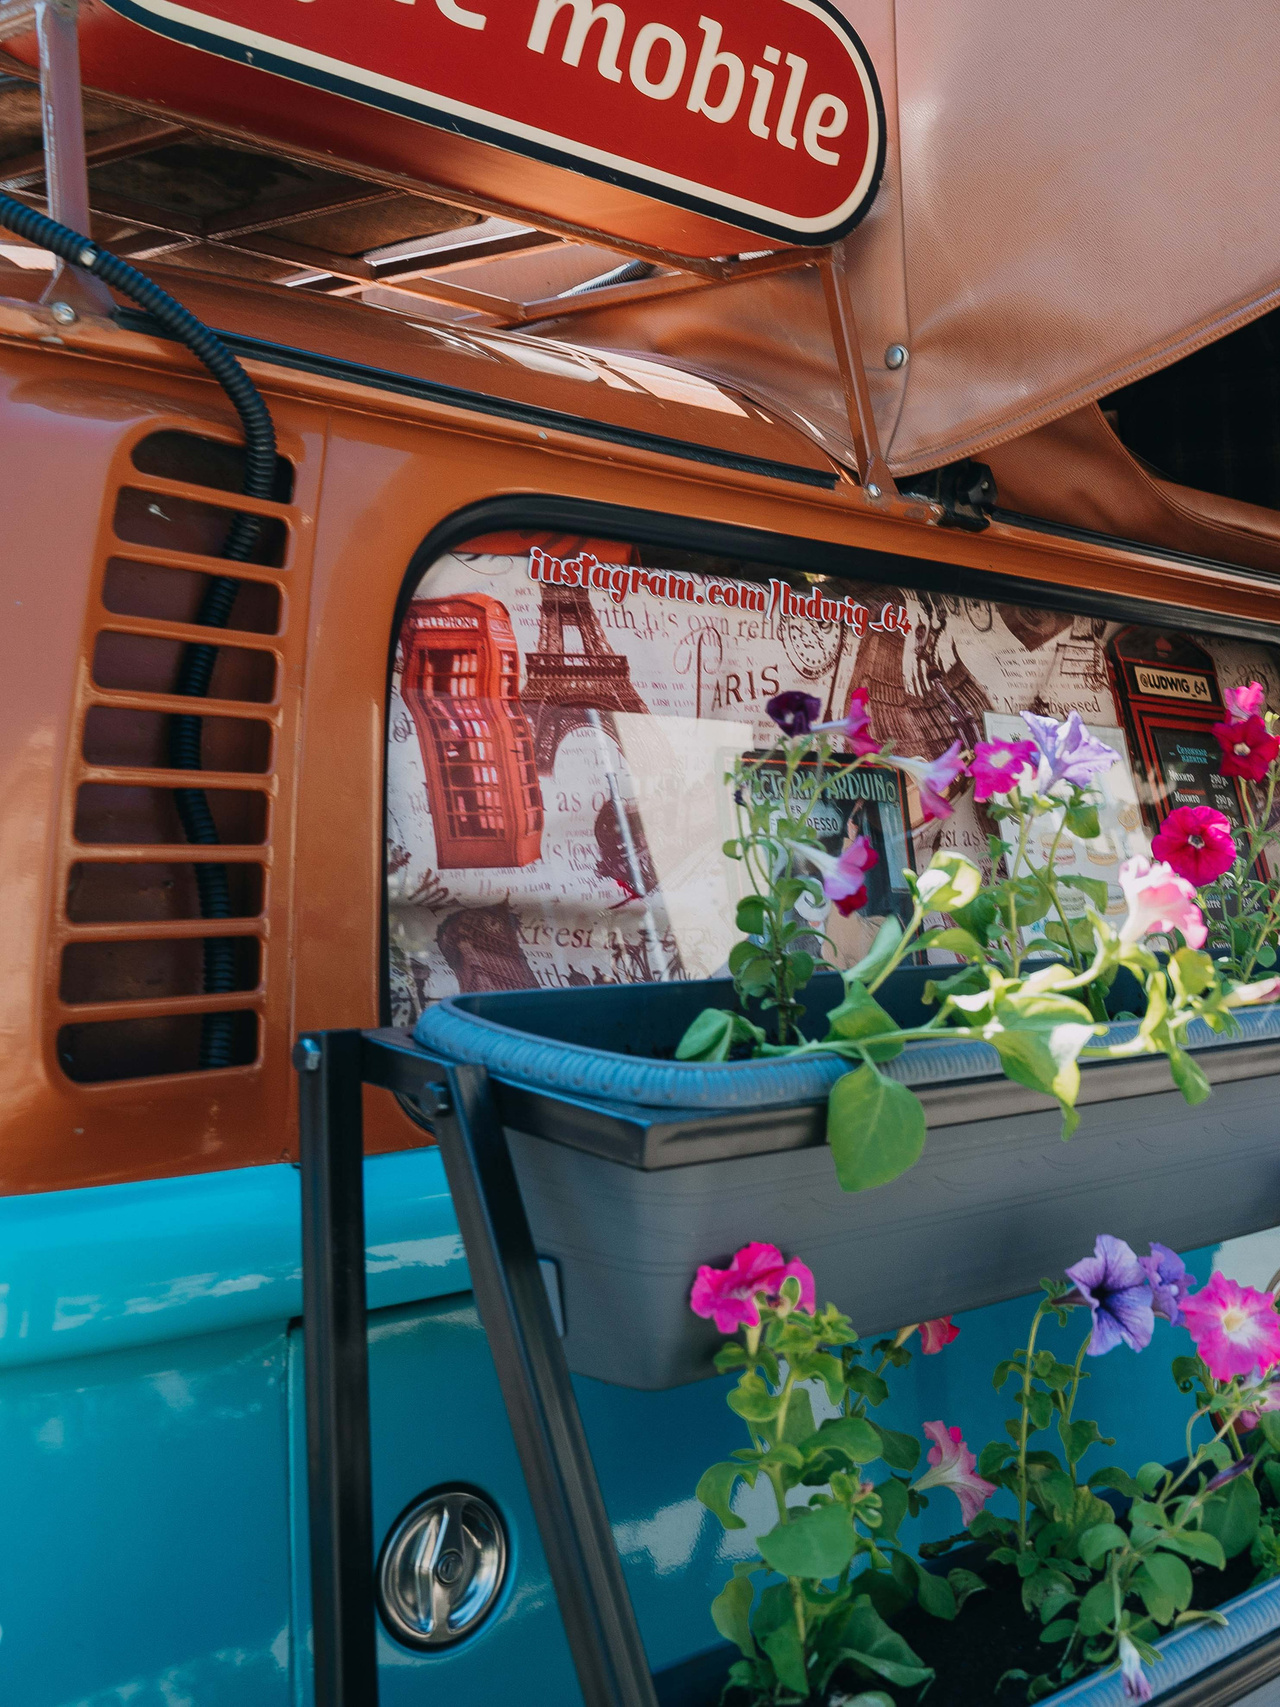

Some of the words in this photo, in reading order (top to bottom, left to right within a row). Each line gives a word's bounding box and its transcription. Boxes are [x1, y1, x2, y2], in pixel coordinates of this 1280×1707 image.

[526, 0, 849, 167] mobile
[528, 546, 912, 639] instagram.com/ludwig_64
[1139, 673, 1209, 698] @LUDWIG_64
